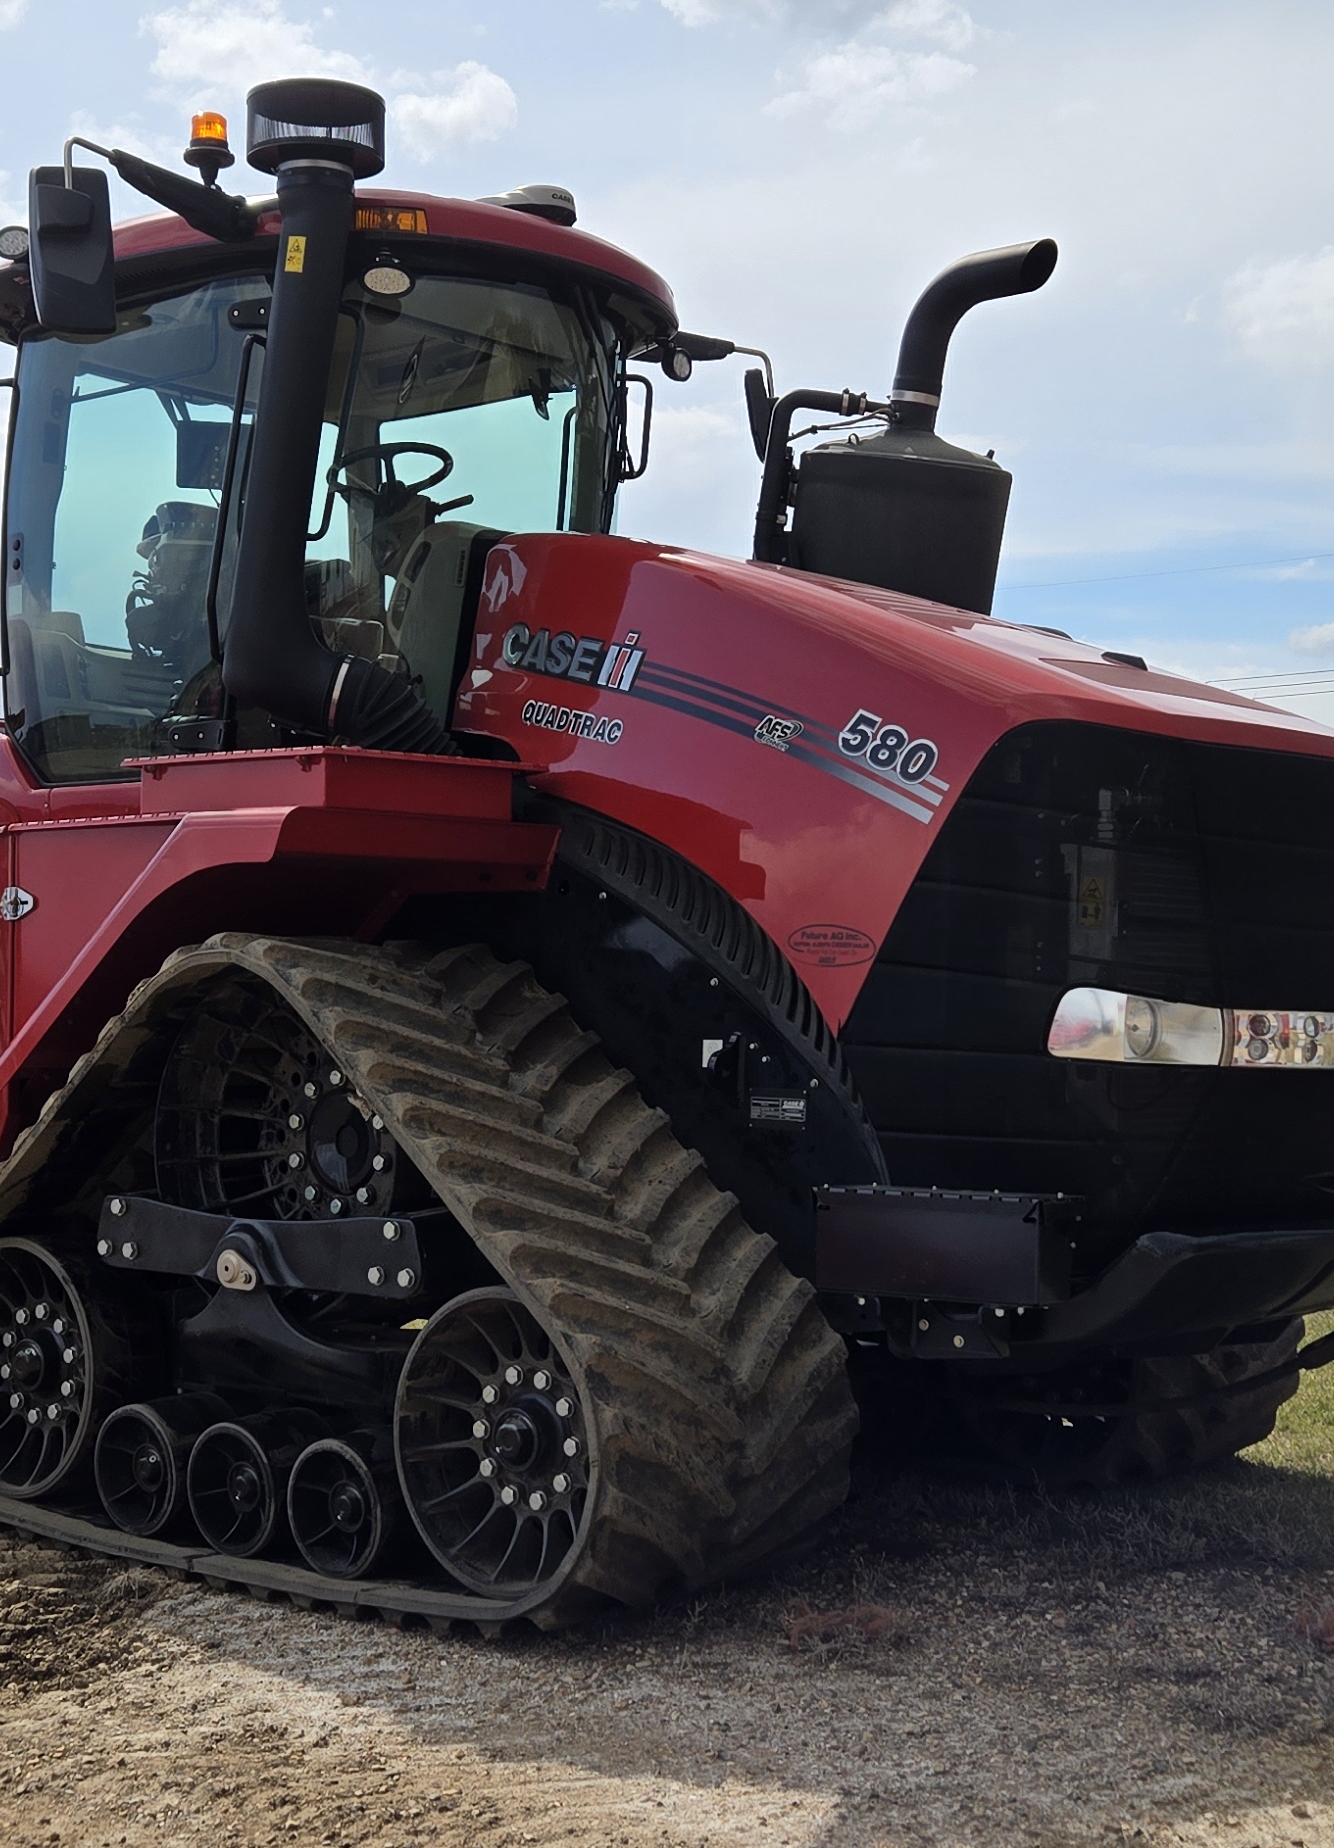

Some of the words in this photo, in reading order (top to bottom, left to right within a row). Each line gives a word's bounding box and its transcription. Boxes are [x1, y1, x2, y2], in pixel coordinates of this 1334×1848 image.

[501, 622, 605, 682] CASE
[522, 699, 624, 745] QUADTRAC
[755, 715, 796, 740] AFS
[838, 708, 938, 785] 580
